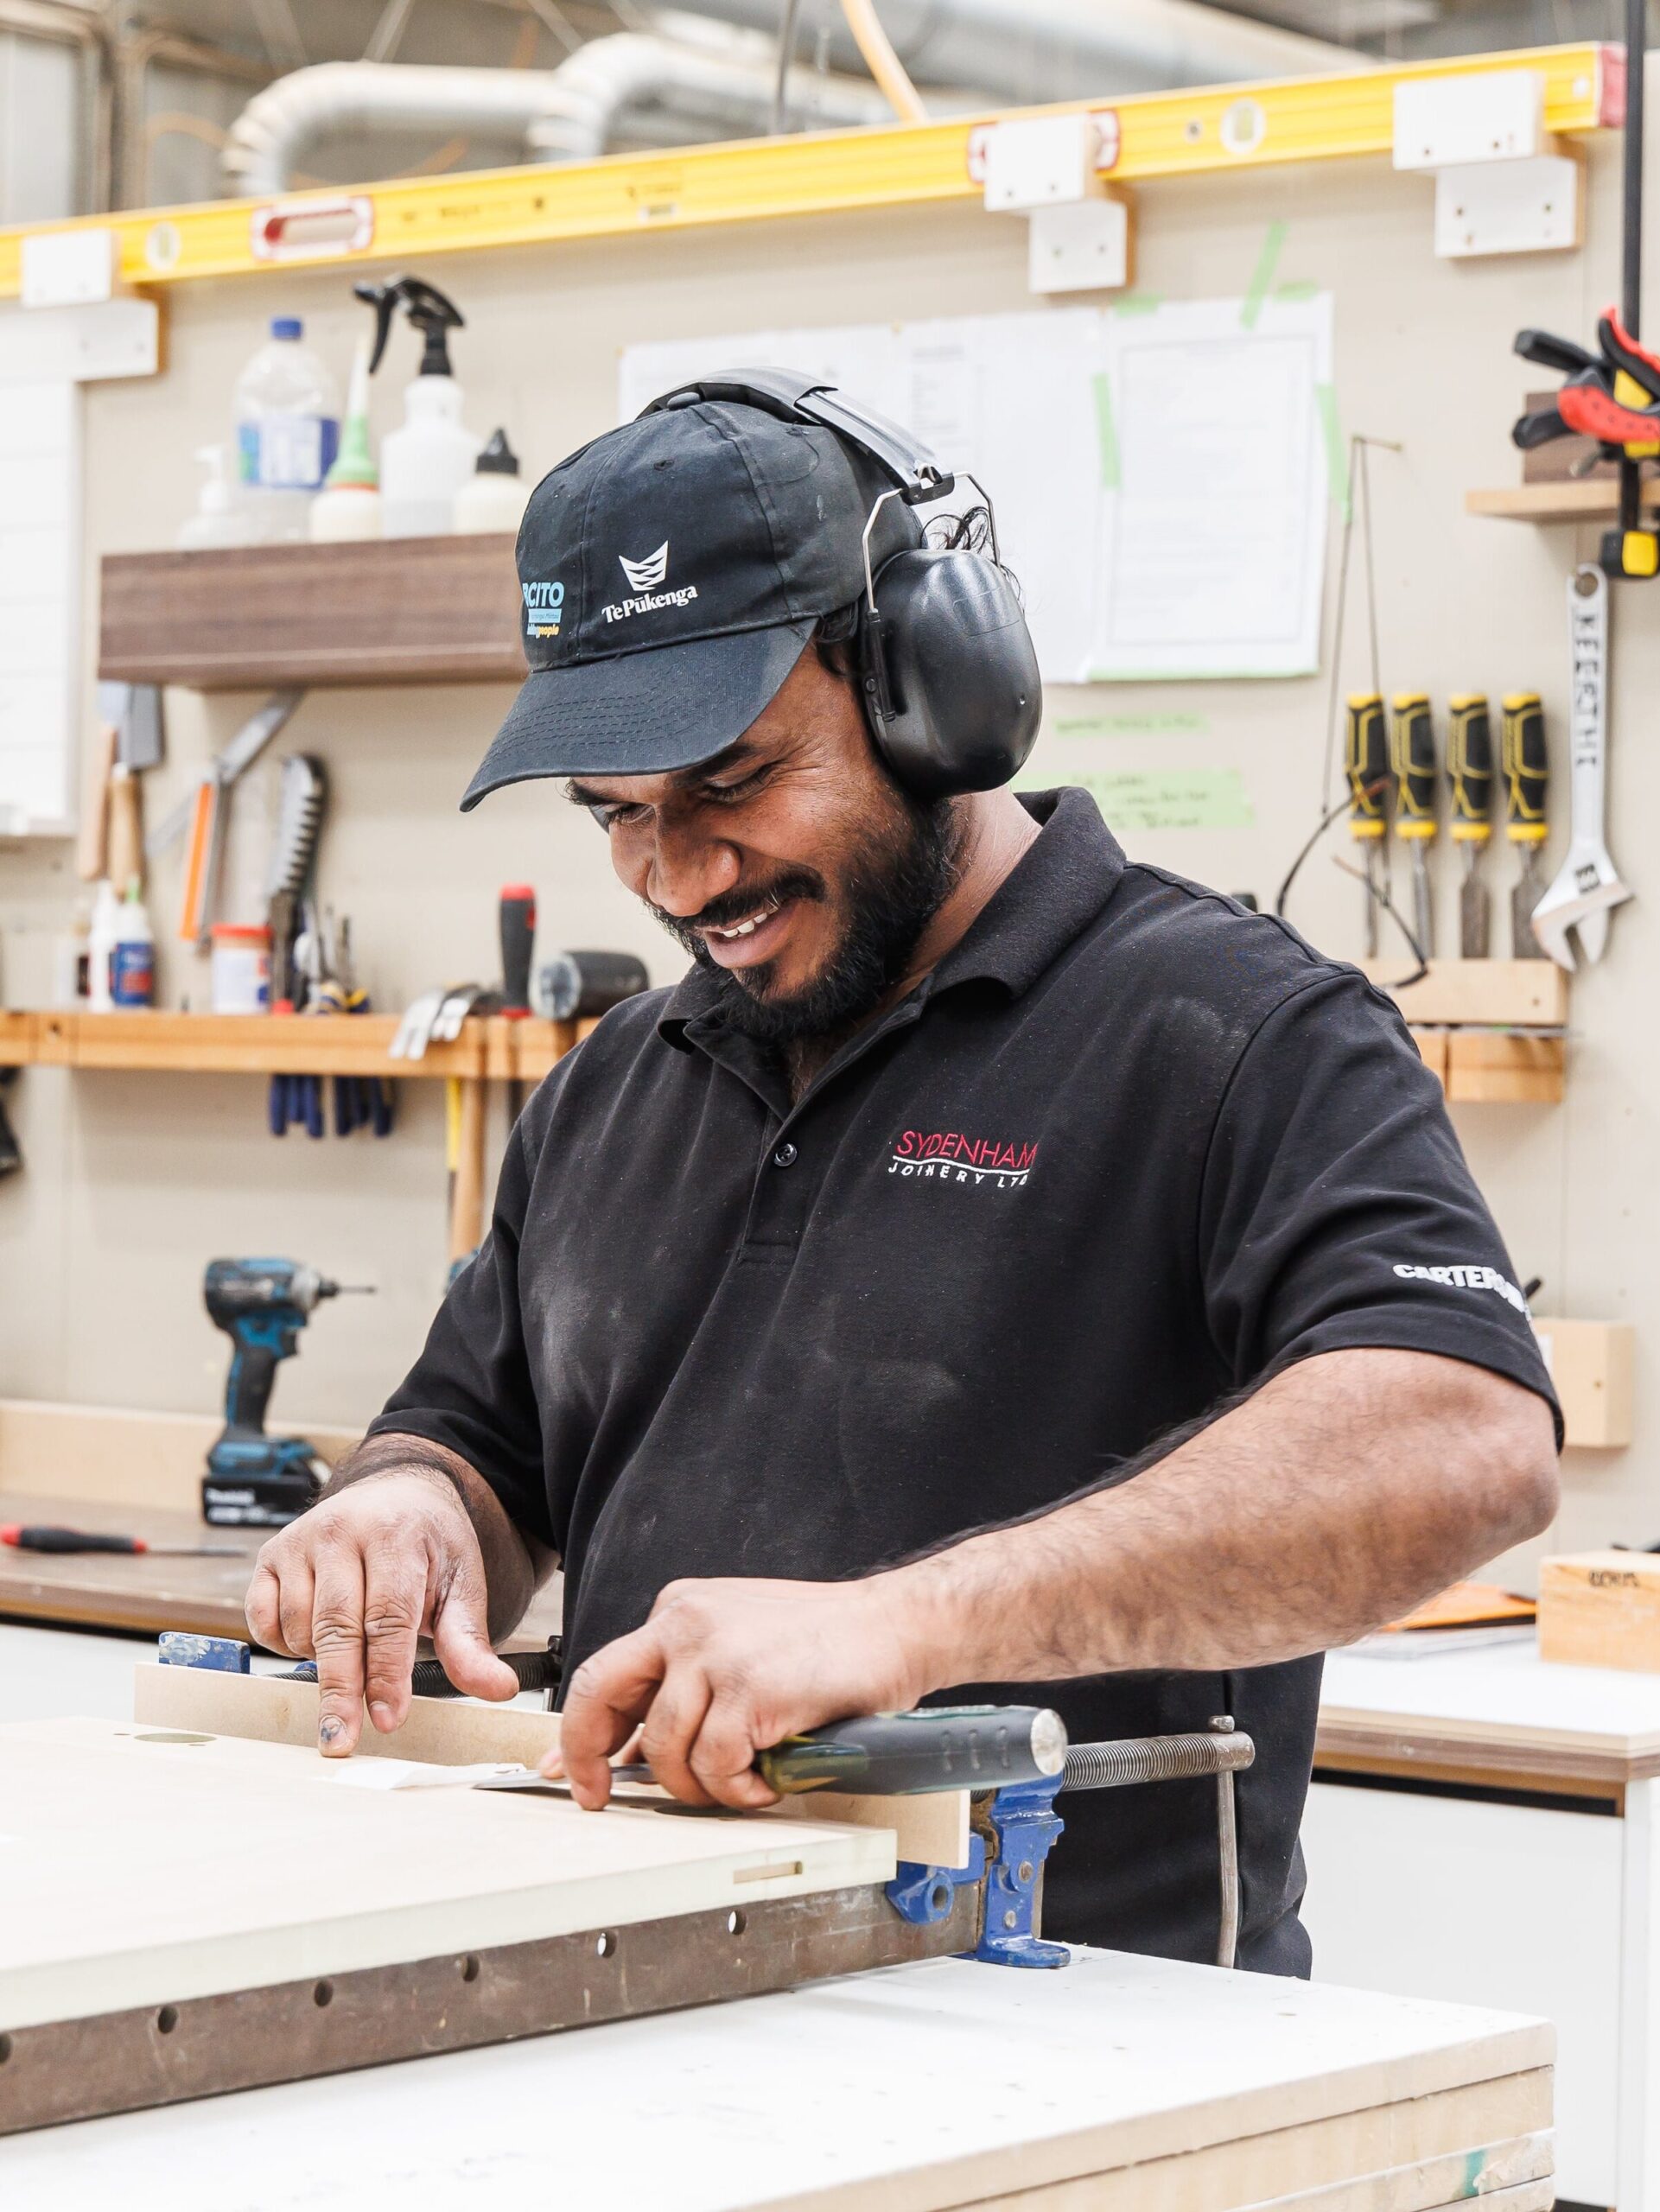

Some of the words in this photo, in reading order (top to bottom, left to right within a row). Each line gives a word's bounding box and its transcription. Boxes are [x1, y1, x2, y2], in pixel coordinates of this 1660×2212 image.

[896, 1130, 1040, 1168] SYDENHAM
[888, 1162, 985, 1184] JOINERY
[997, 1174, 1028, 1188] LTD
